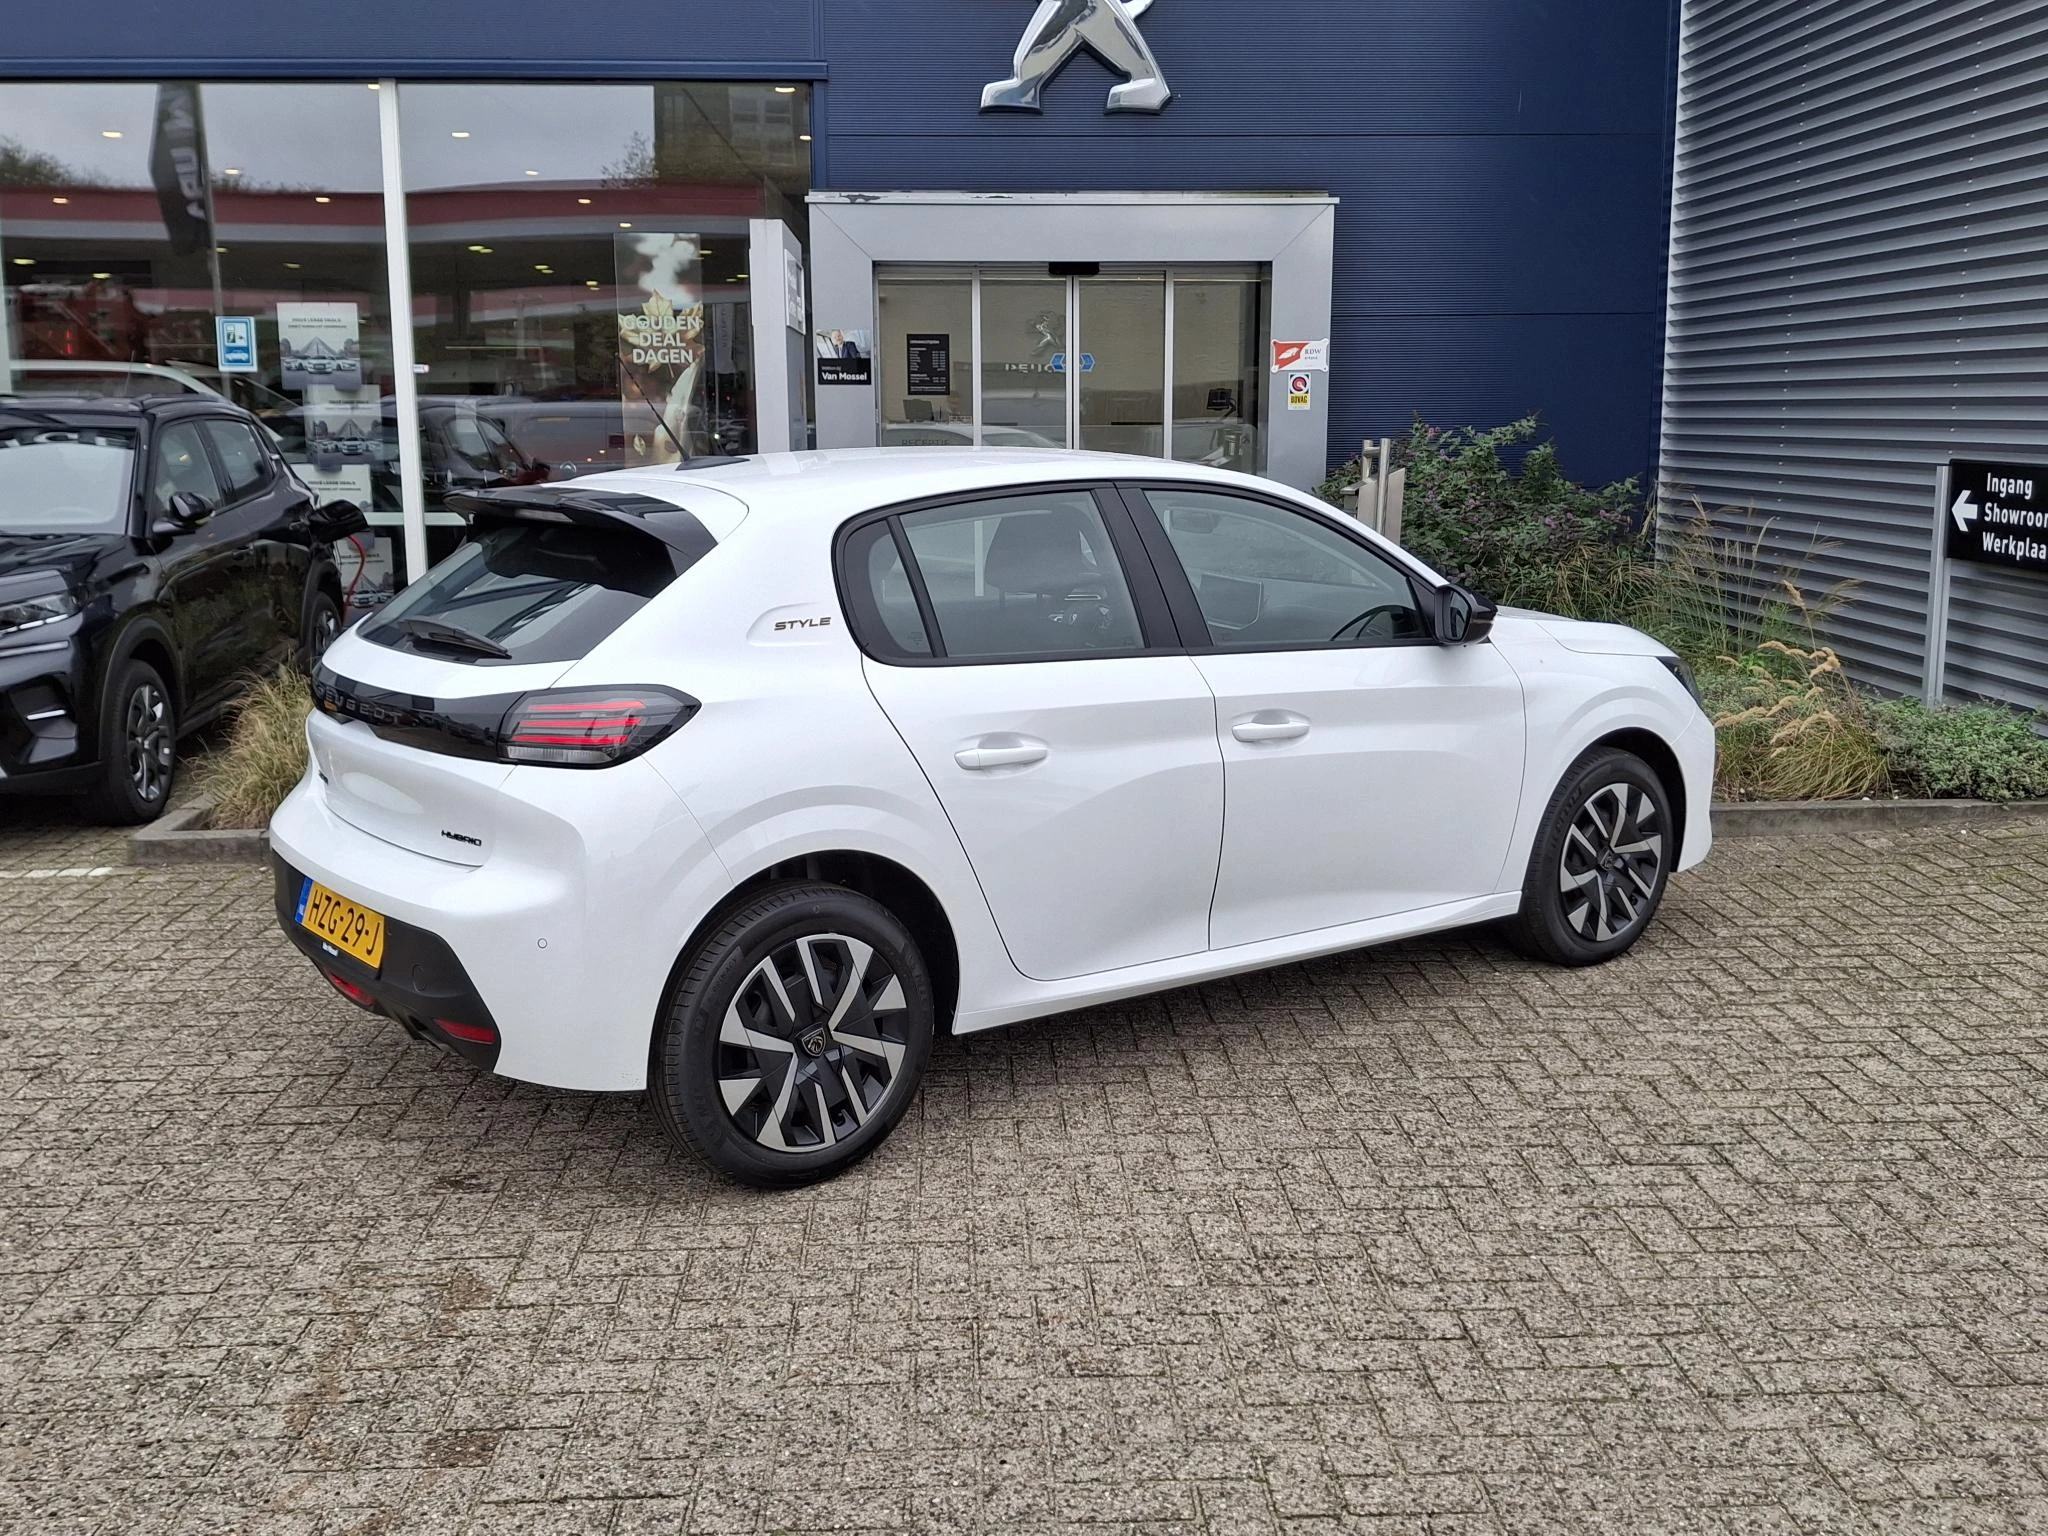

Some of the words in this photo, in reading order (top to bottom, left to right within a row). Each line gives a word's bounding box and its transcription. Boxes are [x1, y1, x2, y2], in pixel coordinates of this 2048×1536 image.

[622, 315, 700, 330] GOUDEN
[640, 332, 687, 347] DEAL
[632, 348, 694, 364] DAGEN
[821, 371, 837, 381] Van
[839, 371, 867, 381] Mossel
[1986, 472, 2033, 500] Ingang
[1982, 531, 2048, 561] Werkplaa
[774, 616, 832, 632] STYLE
[316, 681, 403, 727] PEUGEOT
[441, 829, 482, 847] HYBRID
